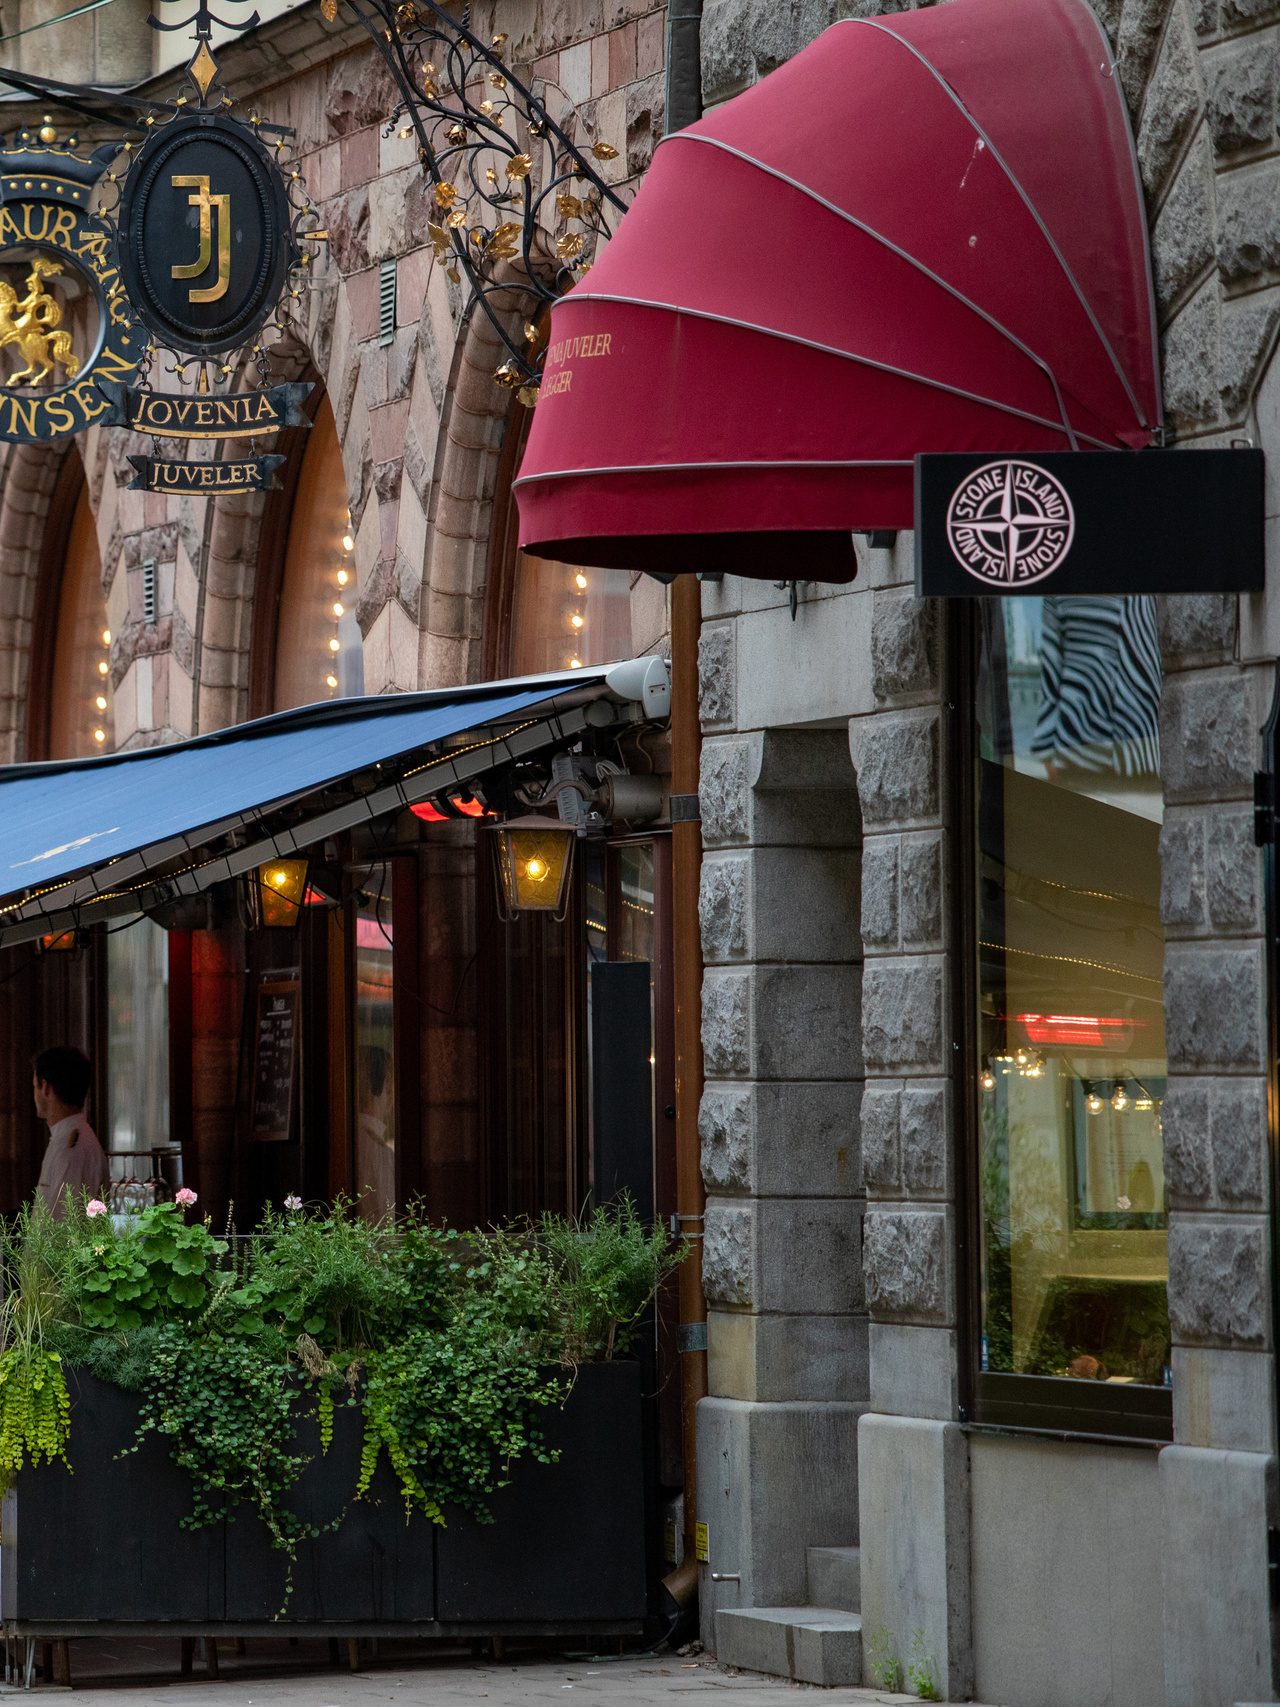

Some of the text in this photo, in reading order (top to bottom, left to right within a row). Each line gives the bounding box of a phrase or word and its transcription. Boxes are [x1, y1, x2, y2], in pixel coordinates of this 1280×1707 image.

[560, 333, 612, 367] JUVELER
[131, 393, 279, 425] JOVENIA
[149, 462, 263, 486] JUVELER
[955, 468, 1066, 519] STONE ISLAND
[955, 528, 1065, 578] STONE ISLAND
